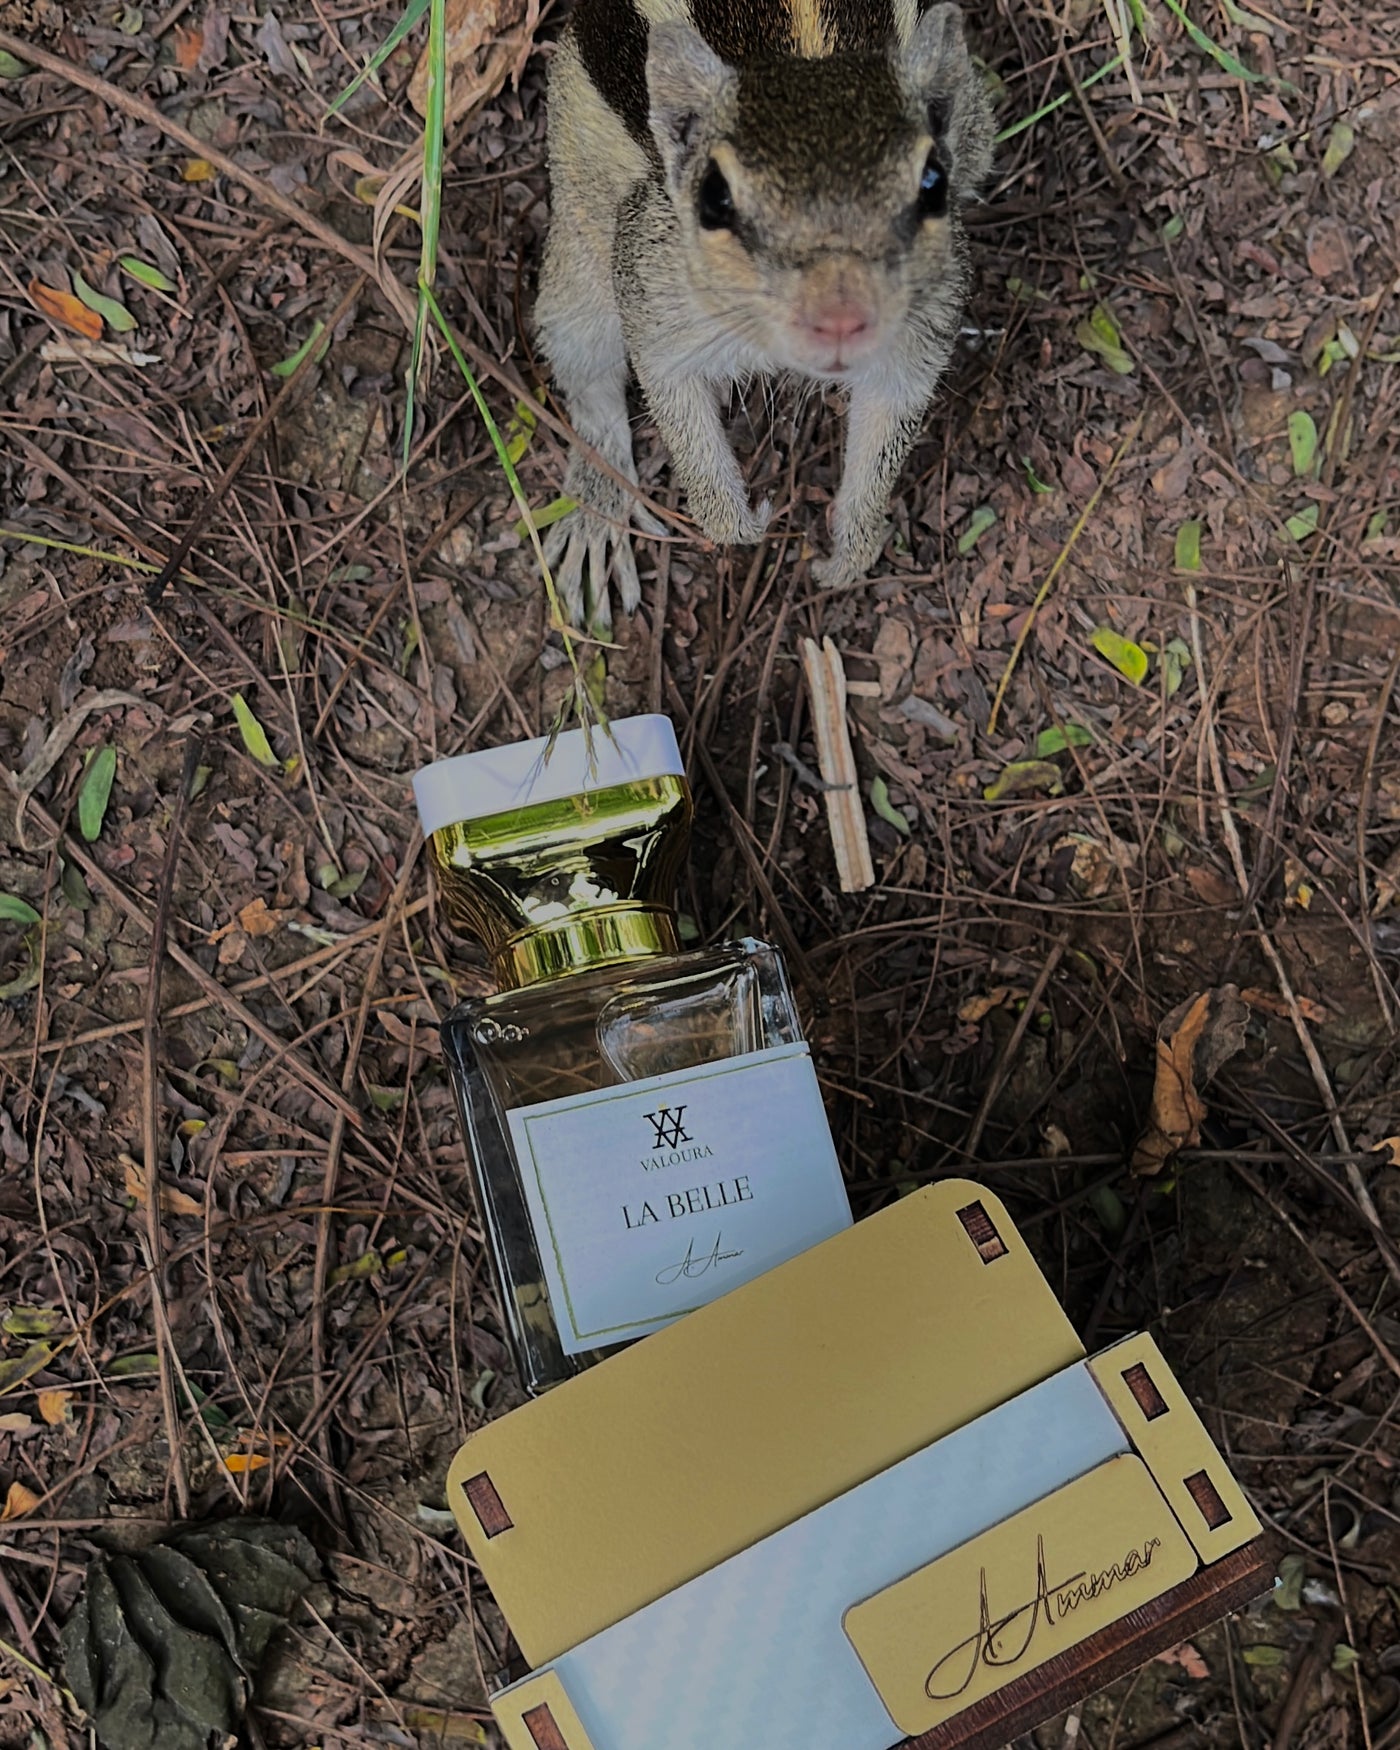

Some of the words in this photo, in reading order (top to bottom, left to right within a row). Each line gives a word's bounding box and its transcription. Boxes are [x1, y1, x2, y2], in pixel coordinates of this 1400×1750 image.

[640, 1145, 714, 1172] VALOURA
[621, 1200, 661, 1229] LA
[665, 1175, 754, 1218] BELLE
